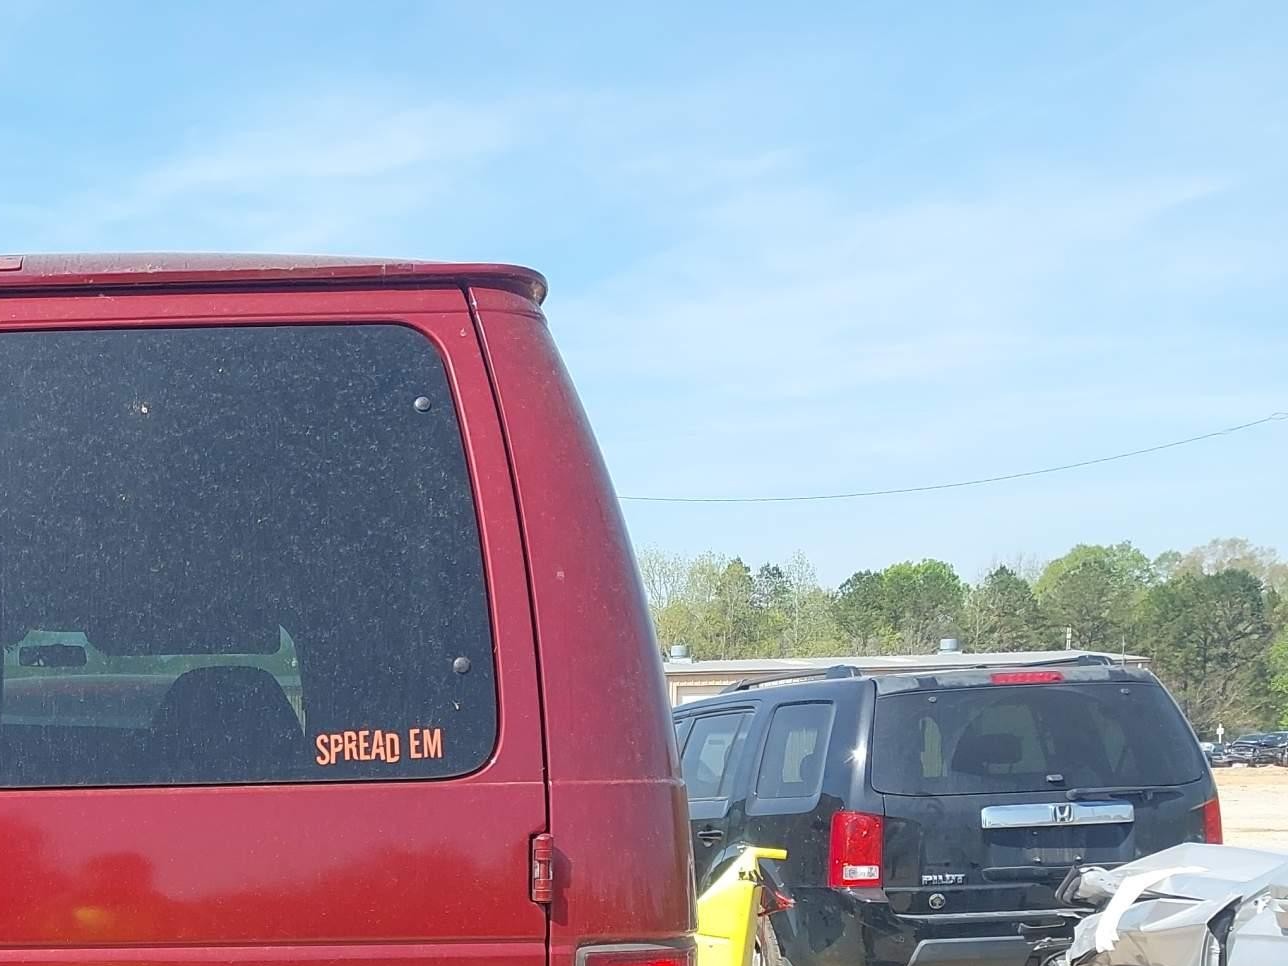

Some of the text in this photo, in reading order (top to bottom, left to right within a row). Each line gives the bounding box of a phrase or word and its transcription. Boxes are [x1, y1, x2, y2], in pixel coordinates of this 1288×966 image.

[315, 728, 444, 767] SPREAD EM
[921, 873, 966, 885] PILOT
